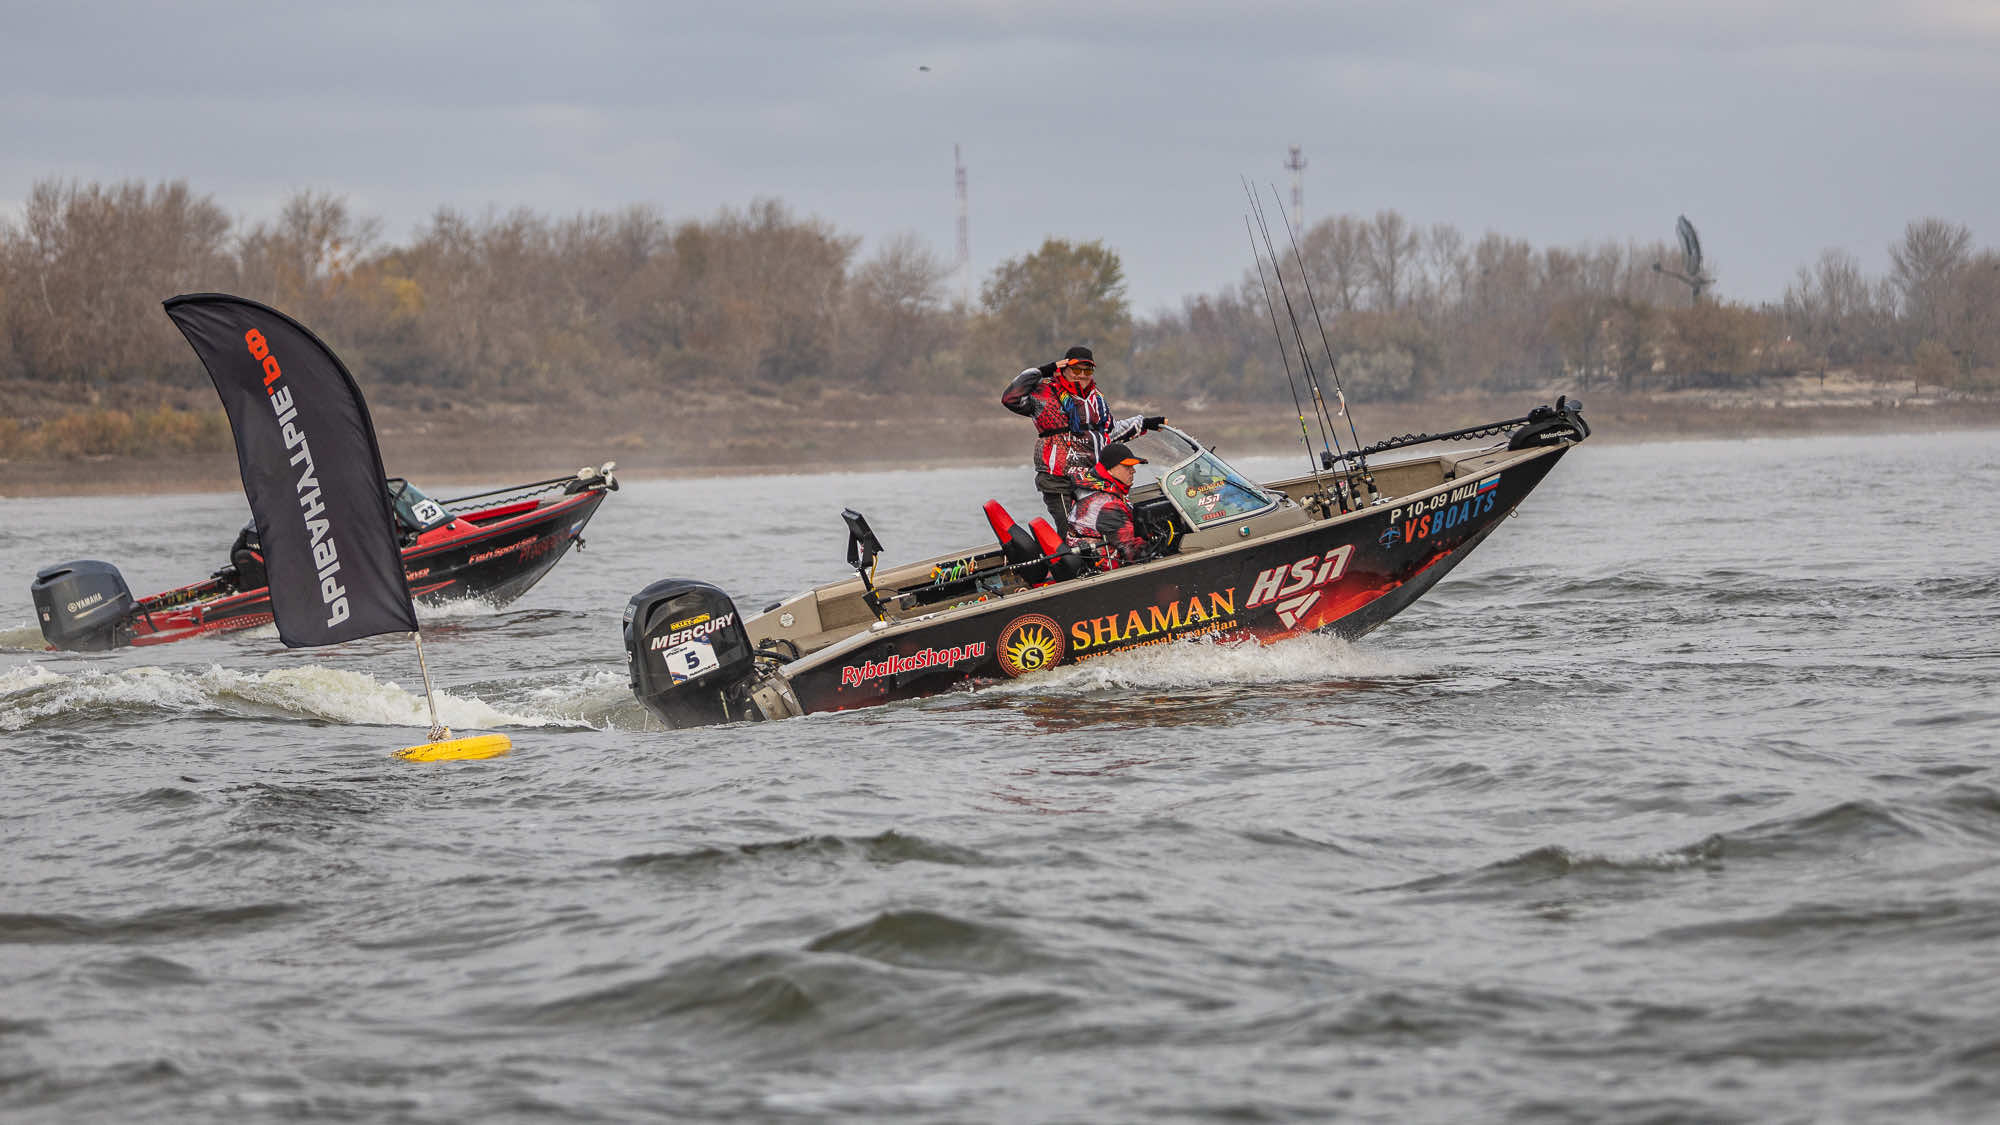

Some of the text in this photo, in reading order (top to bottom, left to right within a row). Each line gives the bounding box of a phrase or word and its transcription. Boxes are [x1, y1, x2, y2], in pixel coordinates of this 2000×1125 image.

[420, 506, 438, 520] 23
[1406, 493, 1447, 519] 10-09
[76, 592, 103, 609] YAMAHA
[650, 612, 734, 651] MERCURY
[1071, 587, 1236, 651] SHAMAN
[684, 650, 700, 669] 5
[842, 641, 985, 687] RybalkaShop.ru
